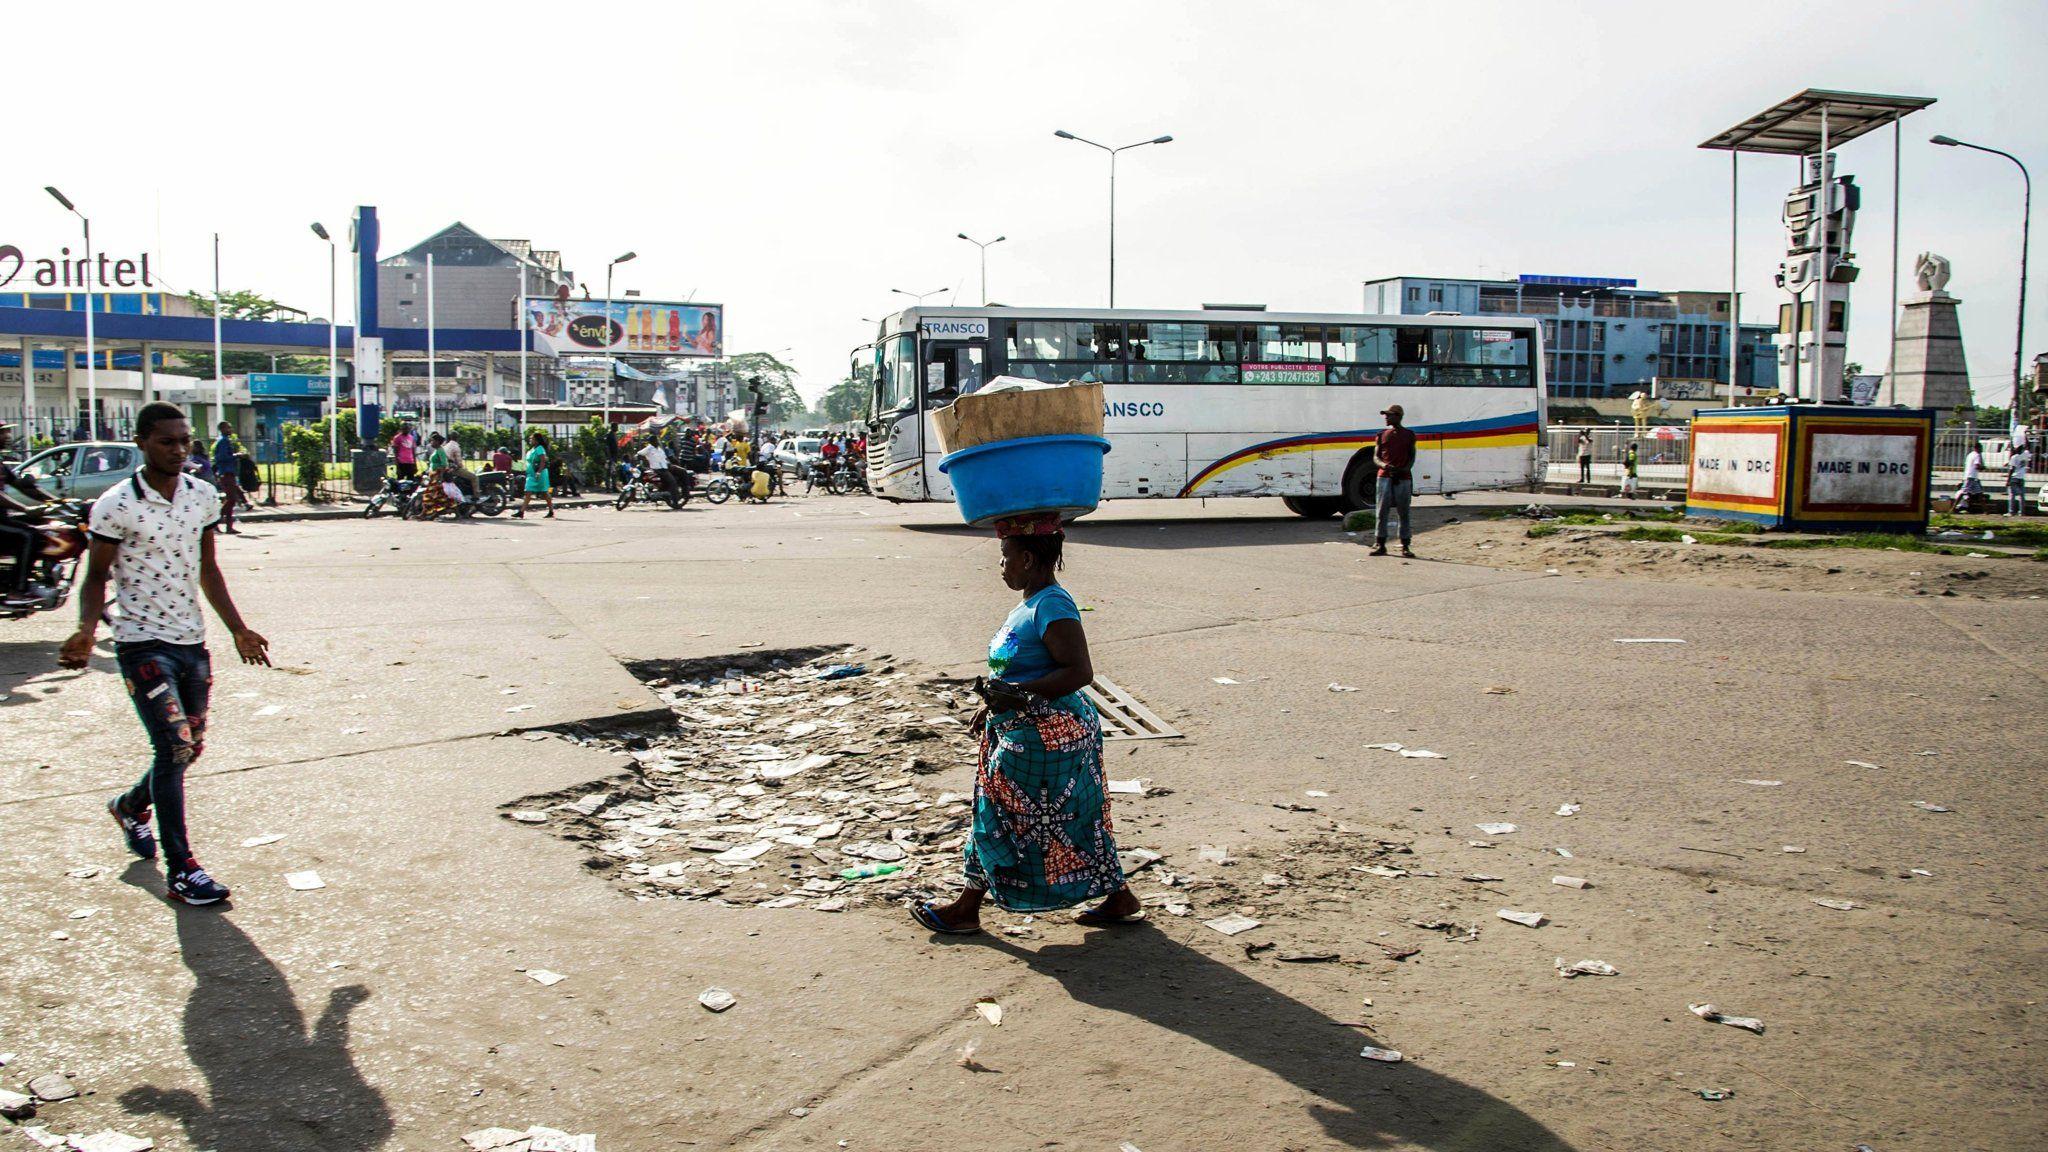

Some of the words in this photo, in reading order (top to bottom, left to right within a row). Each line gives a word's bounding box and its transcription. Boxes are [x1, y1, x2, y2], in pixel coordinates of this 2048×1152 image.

[35, 247, 153, 287] airtel
[925, 323, 985, 334] TRANSCO
[1256, 371, 1276, 382] +243
[1278, 371, 1320, 383] 972471325
[1104, 402, 1164, 417] ANSCO
[1698, 458, 1720, 471] MADE
[1727, 459, 1738, 471] IN
[1747, 460, 1772, 473] DRC
[1817, 461, 1852, 474] MADE
[1857, 461, 1871, 474] IN
[1878, 462, 1910, 475] DRC
